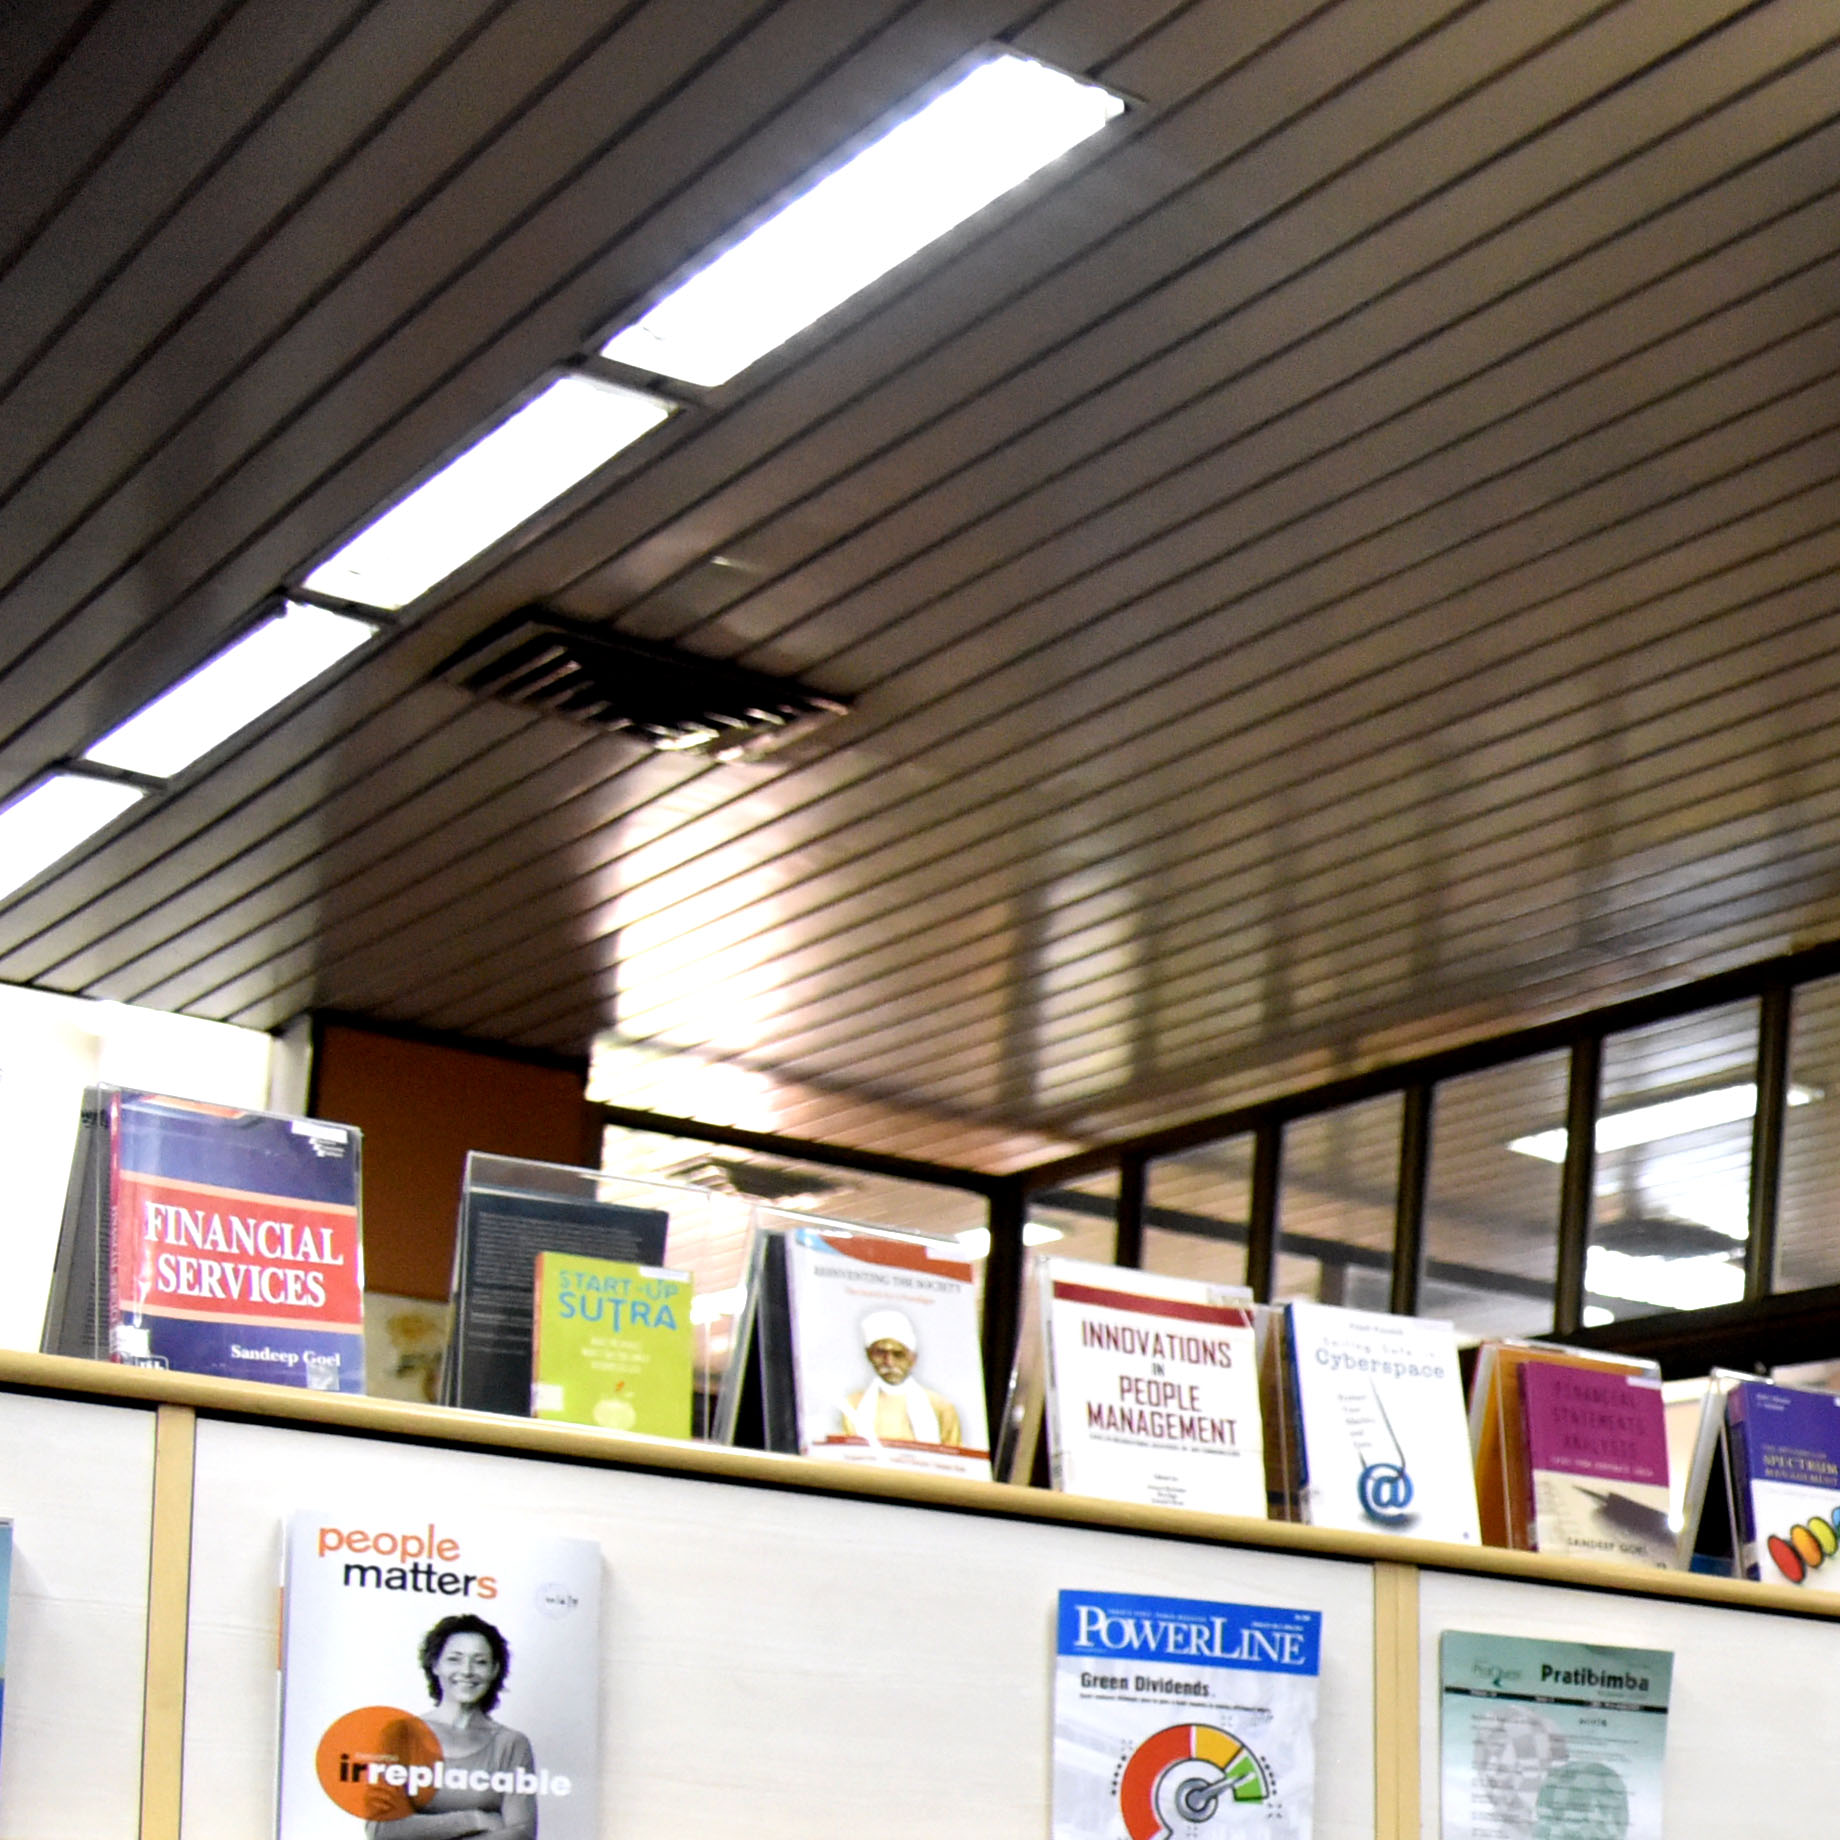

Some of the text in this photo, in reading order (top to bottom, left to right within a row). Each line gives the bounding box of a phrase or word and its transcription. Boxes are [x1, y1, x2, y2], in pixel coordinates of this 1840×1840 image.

[145, 1201, 344, 1265] FINANCIAL
[157, 1254, 326, 1308] SERVICES
[559, 1291, 677, 1333] SUTRA
[231, 1344, 341, 1368] Sandeep Goel
[1082, 1320, 1232, 1368] INNOVATIONS
[1315, 1347, 1445, 1379] Cyberspace
[1153, 1363, 1165, 1376] IN
[1120, 1376, 1201, 1412] PEOPLE
[1087, 1401, 1237, 1445] MANAGEMENT
[1764, 1454, 1838, 1476] SPECTRUM
[318, 1523, 460, 1562] people
[343, 1562, 499, 1600] matters
[1081, 1672, 1210, 1698] Green Dividends
[1541, 1664, 1650, 1692] Pratibimba
[339, 1754, 572, 1797] irreplacable
